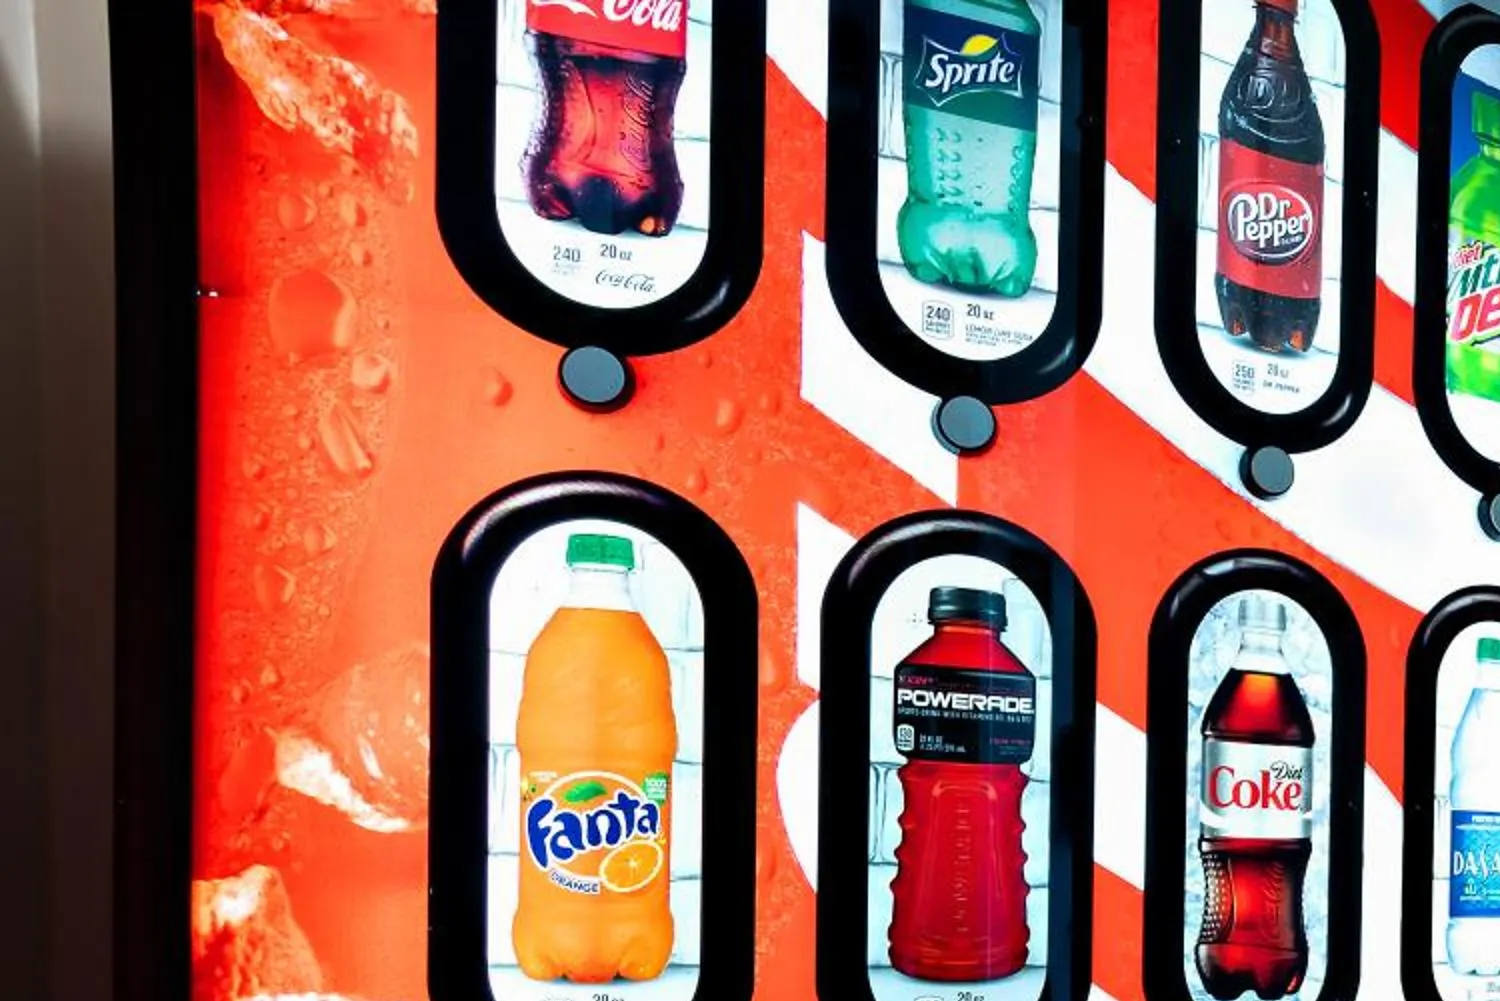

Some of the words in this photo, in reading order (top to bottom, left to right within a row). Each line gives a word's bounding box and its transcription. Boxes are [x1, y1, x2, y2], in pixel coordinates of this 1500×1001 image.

[925, 52, 1015, 93] Sprite
[1258, 192, 1291, 220] Dr
[1228, 192, 1310, 249] Pepper
[553, 245, 581, 263] 240
[600, 243, 617, 259] 20
[926, 305, 951, 321] 240
[966, 303, 981, 319] 20
[897, 688, 1035, 714] POWERADE
[1270, 760, 1303, 779] Diet
[1208, 765, 1302, 811] Coke
[527, 791, 659, 869] Fanta
[550, 868, 599, 893] ORANGE
